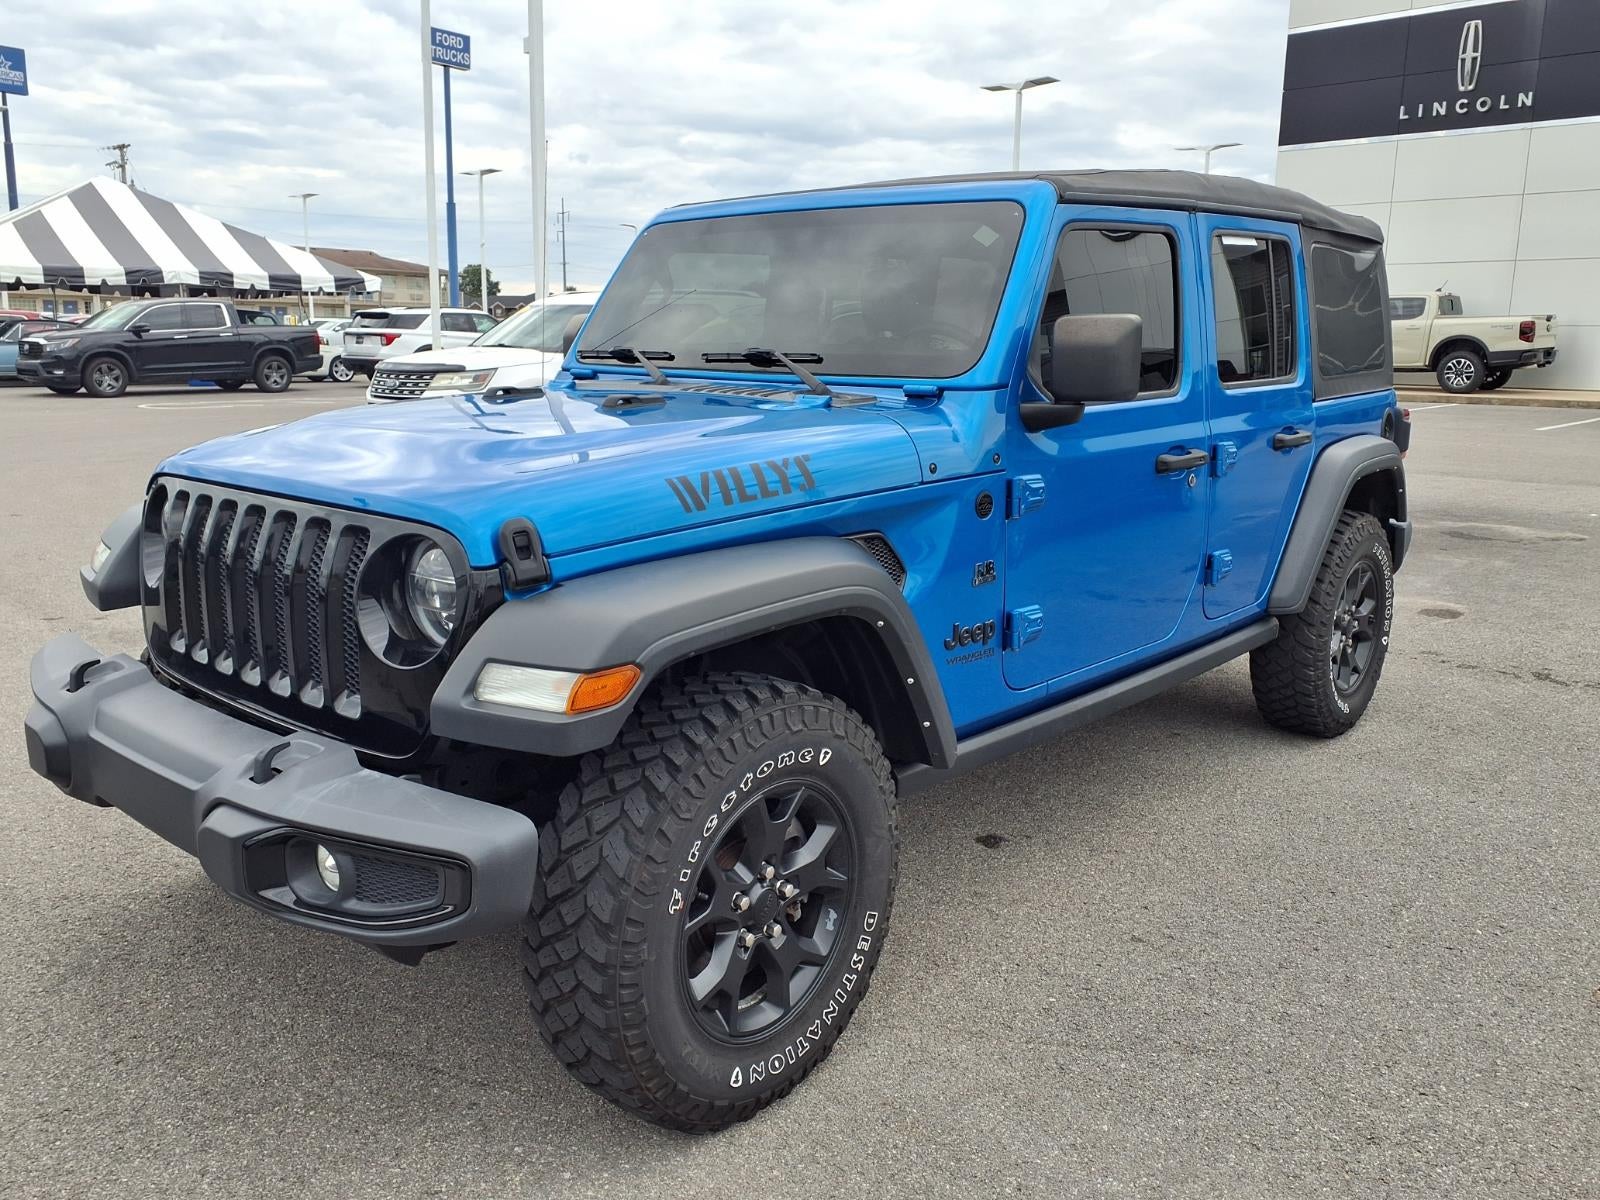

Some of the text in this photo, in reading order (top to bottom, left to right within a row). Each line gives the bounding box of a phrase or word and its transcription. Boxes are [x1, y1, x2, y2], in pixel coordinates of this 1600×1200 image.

[431, 45, 470, 65] TRUCKS
[435, 32, 464, 49] FORD
[1399, 91, 1533, 120] LINCOLN
[664, 454, 816, 514] WILLYS
[943, 619, 996, 651] Jeep
[749, 911, 879, 1084] DESTINATION
